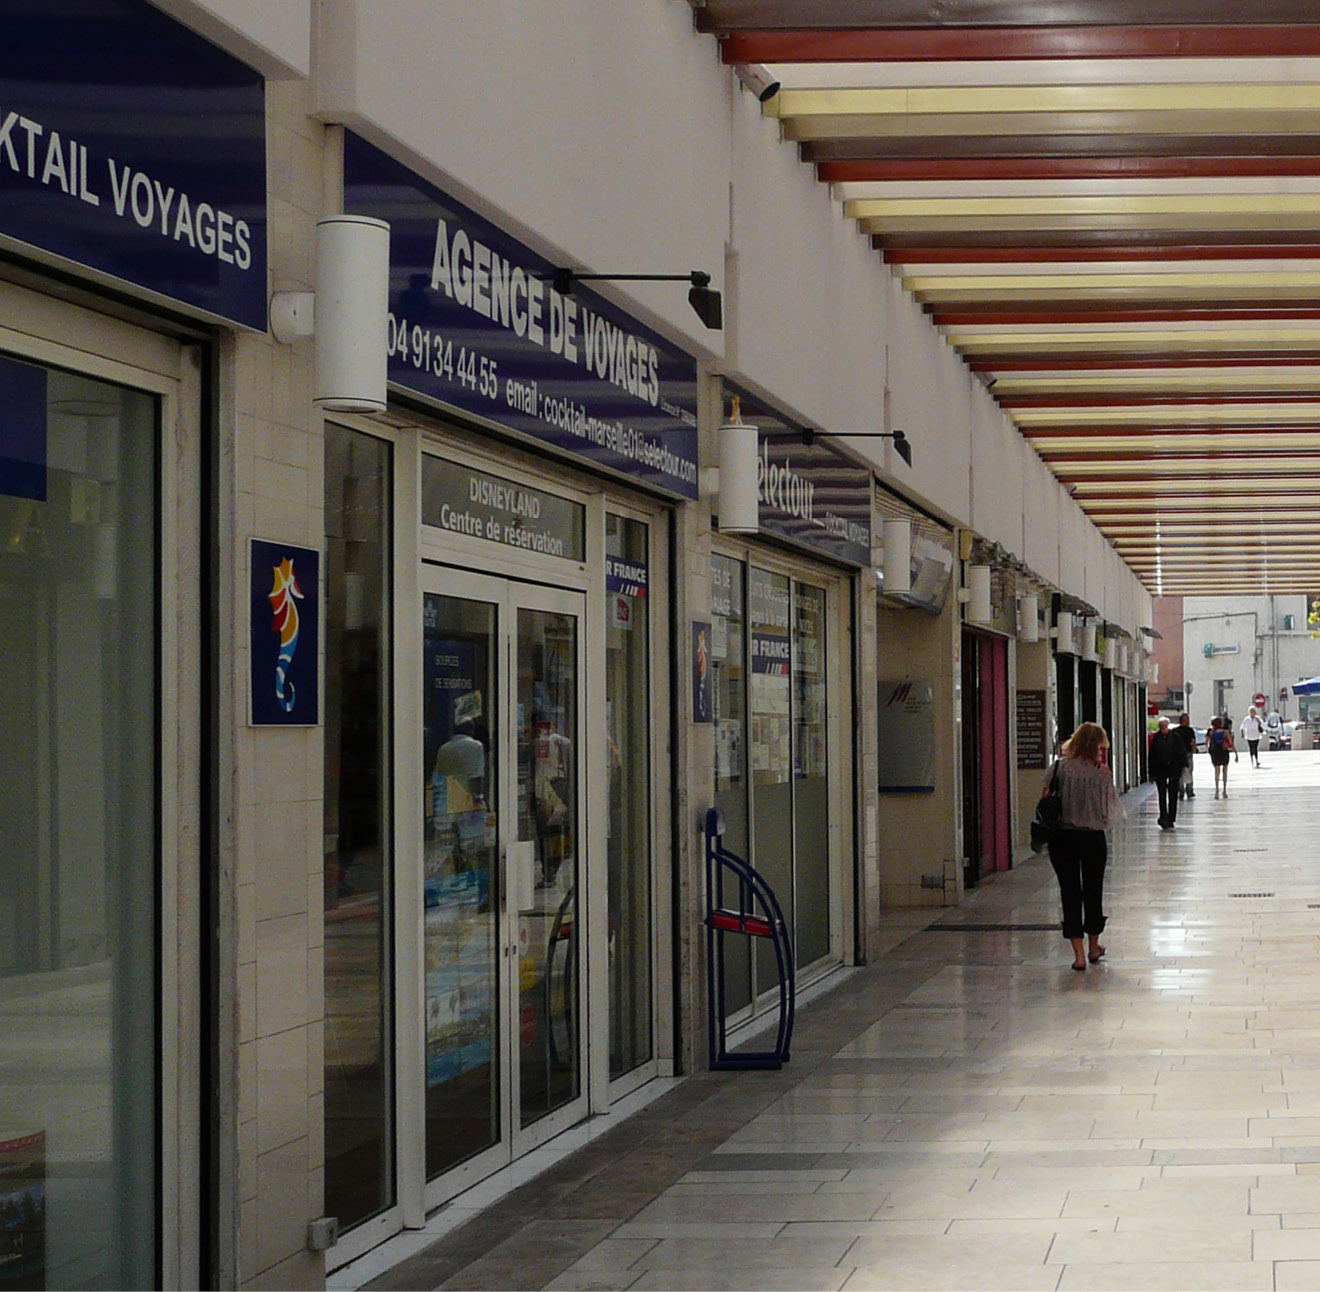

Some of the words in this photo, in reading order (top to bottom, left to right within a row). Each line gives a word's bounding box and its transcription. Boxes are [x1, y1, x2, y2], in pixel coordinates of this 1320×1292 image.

[107, 157, 251, 270] VOYAGES
[431, 218, 544, 347] AGENCE
[550, 286, 578, 364] DE
[582, 306, 660, 408] VOYAGES
[387, 311, 409, 362] 04
[457, 346, 476, 391] 44
[480, 355, 498, 400] 55
[506, 378, 538, 417] email
[469, 477, 540, 519] DISNEYLAND
[441, 503, 482, 537] Centre
[485, 515, 500, 540] de
[504, 520, 563, 556] réservation
[613, 562, 647, 584] FRANCE
[760, 640, 789, 659] FRANCE
